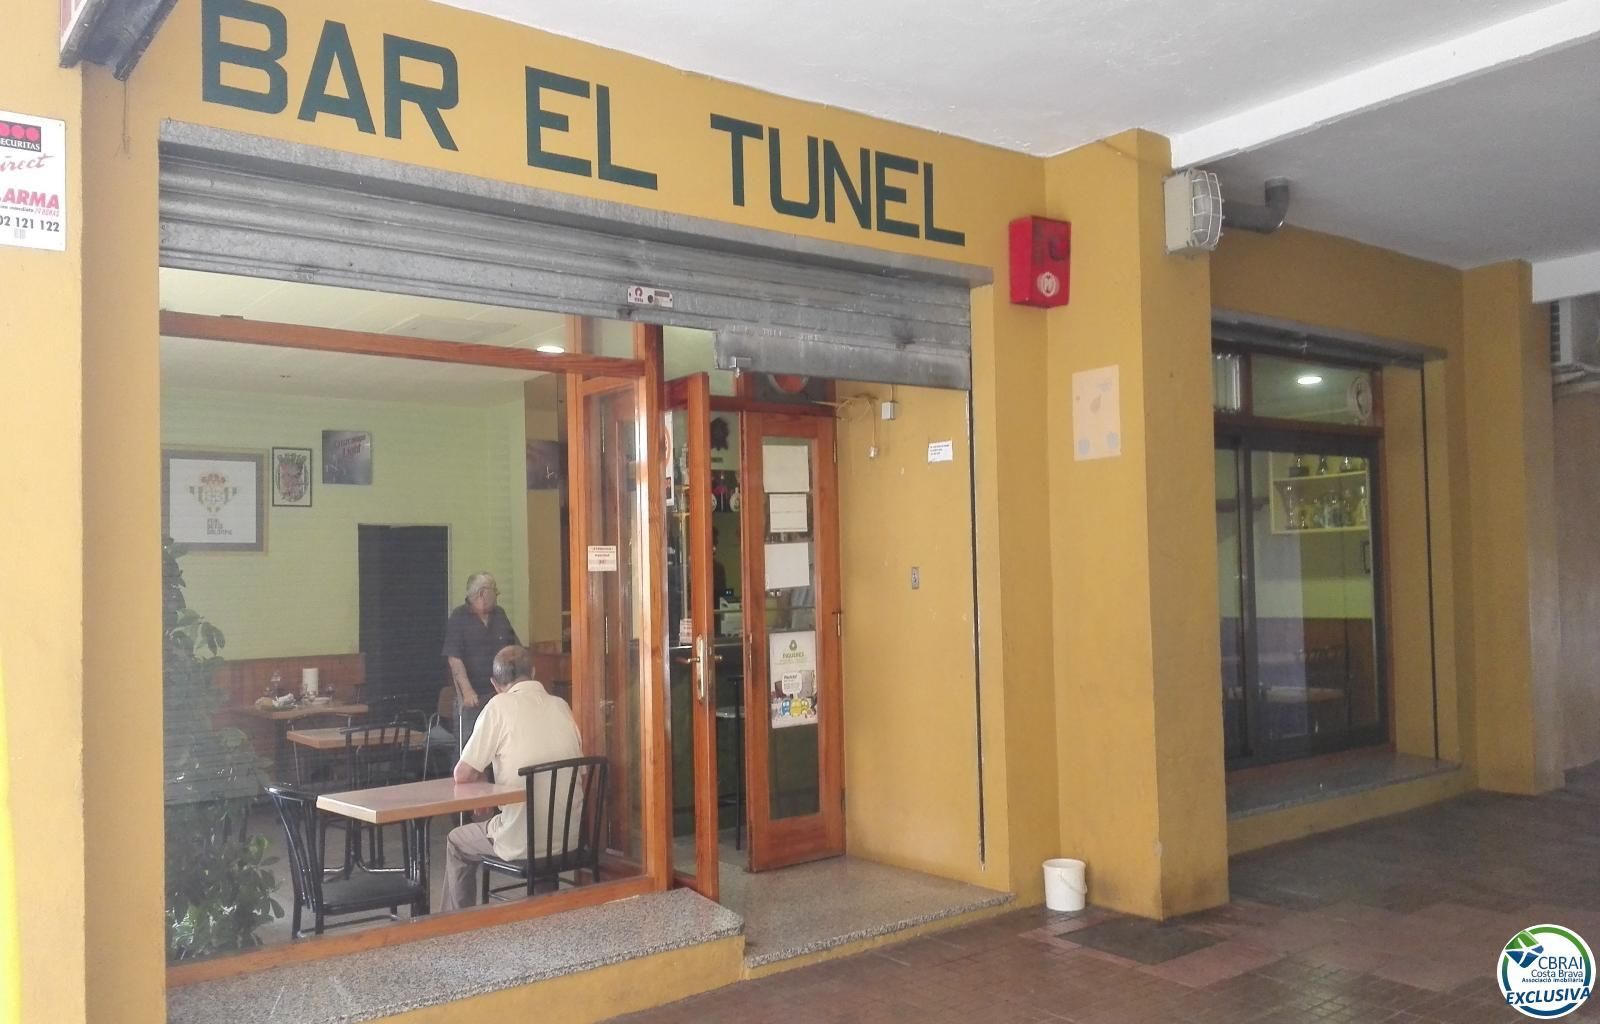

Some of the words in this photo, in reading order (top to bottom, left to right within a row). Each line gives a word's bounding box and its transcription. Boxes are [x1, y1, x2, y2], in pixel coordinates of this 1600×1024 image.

[202, 0, 459, 152] BAR
[525, 65, 658, 191] EL
[710, 113, 966, 247] TUNEL
[0, 138, 40, 150] ECURITAS
[0, 153, 54, 172] irect
[0, 188, 60, 209] ARMA
[15, 216, 34, 229] 121
[40, 220, 60, 232] 122
